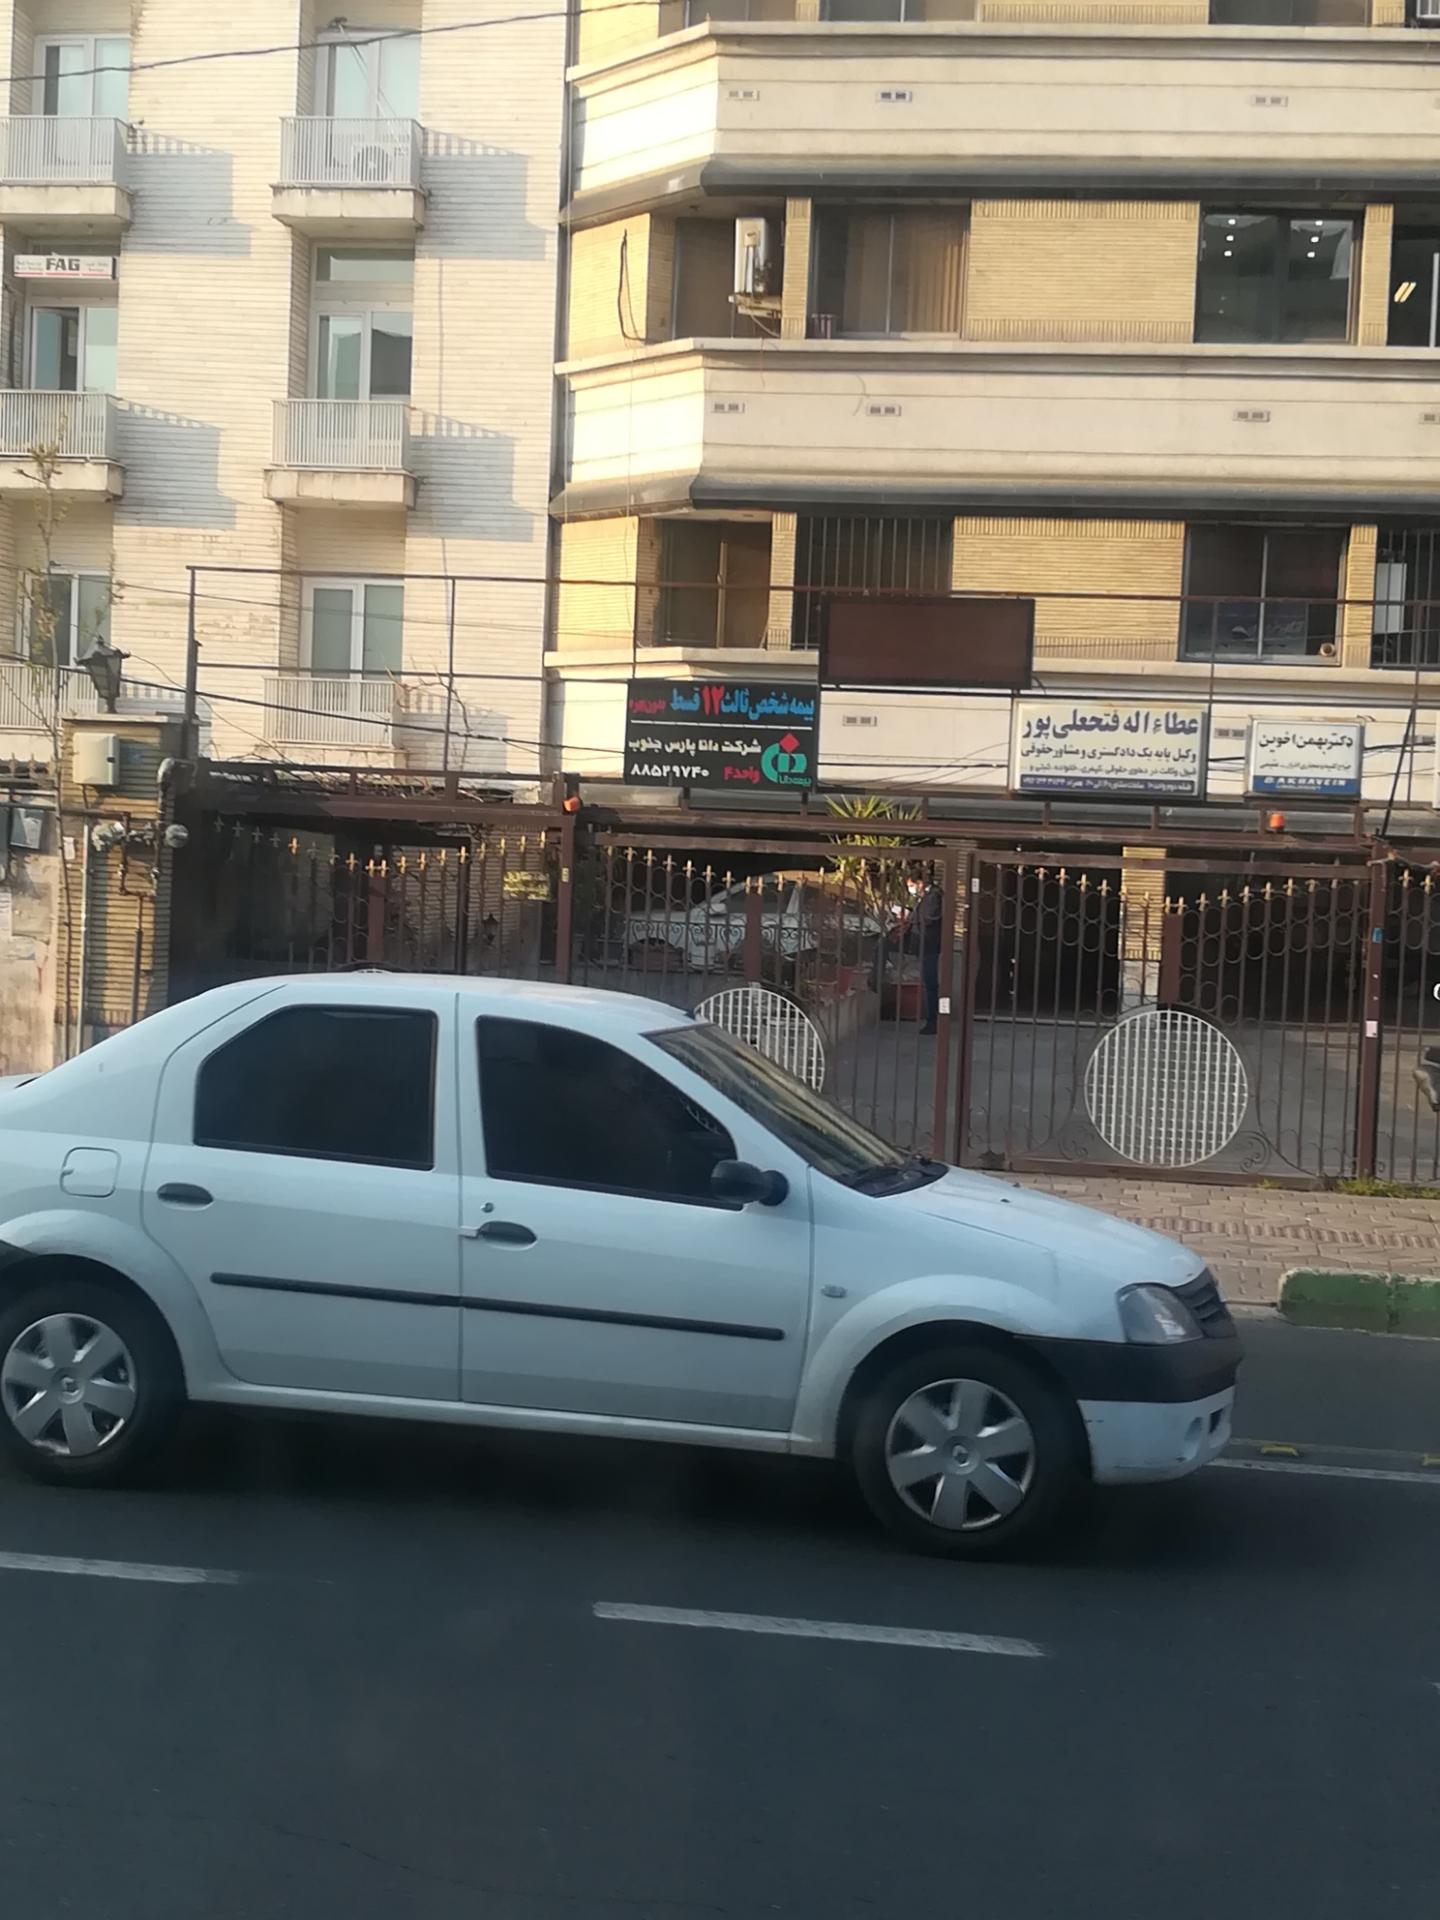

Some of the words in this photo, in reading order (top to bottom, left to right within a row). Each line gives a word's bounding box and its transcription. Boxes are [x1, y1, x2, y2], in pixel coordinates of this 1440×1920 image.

[46, 258, 80, 271] FAG
[669, 687, 700, 711] قسط
[701, 685, 725, 716] ۱۲
[720, 687, 749, 714] ثالث
[748, 690, 789, 720] شخص
[790, 698, 815, 720] بیمه
[1022, 714, 1051, 741] پور
[1123, 710, 1150, 734] اله
[1152, 711, 1200, 736] عطاء
[628, 736, 662, 753] جنوب
[664, 738, 696, 757] پارس
[698, 739, 719, 752] دانا
[722, 738, 762, 756] شرکت
[1259, 731, 1296, 753] اخوین
[1296, 735, 1329, 755] بهمن
[1329, 732, 1354, 749] دکتر
[1021, 742, 1053, 758] حقوقی
[1053, 743, 1080, 758] مشاور
[1087, 746, 1135, 760] دادگستری
[1137, 747, 1152, 761] یک
[1154, 747, 1171, 762] پایه
[1172, 747, 1197, 763] وکیل
[630, 762, 710, 779] ۸۸۵۲۹۷۴۰
[723, 766, 733, 780] ۴
[733, 766, 761, 784] واحد
